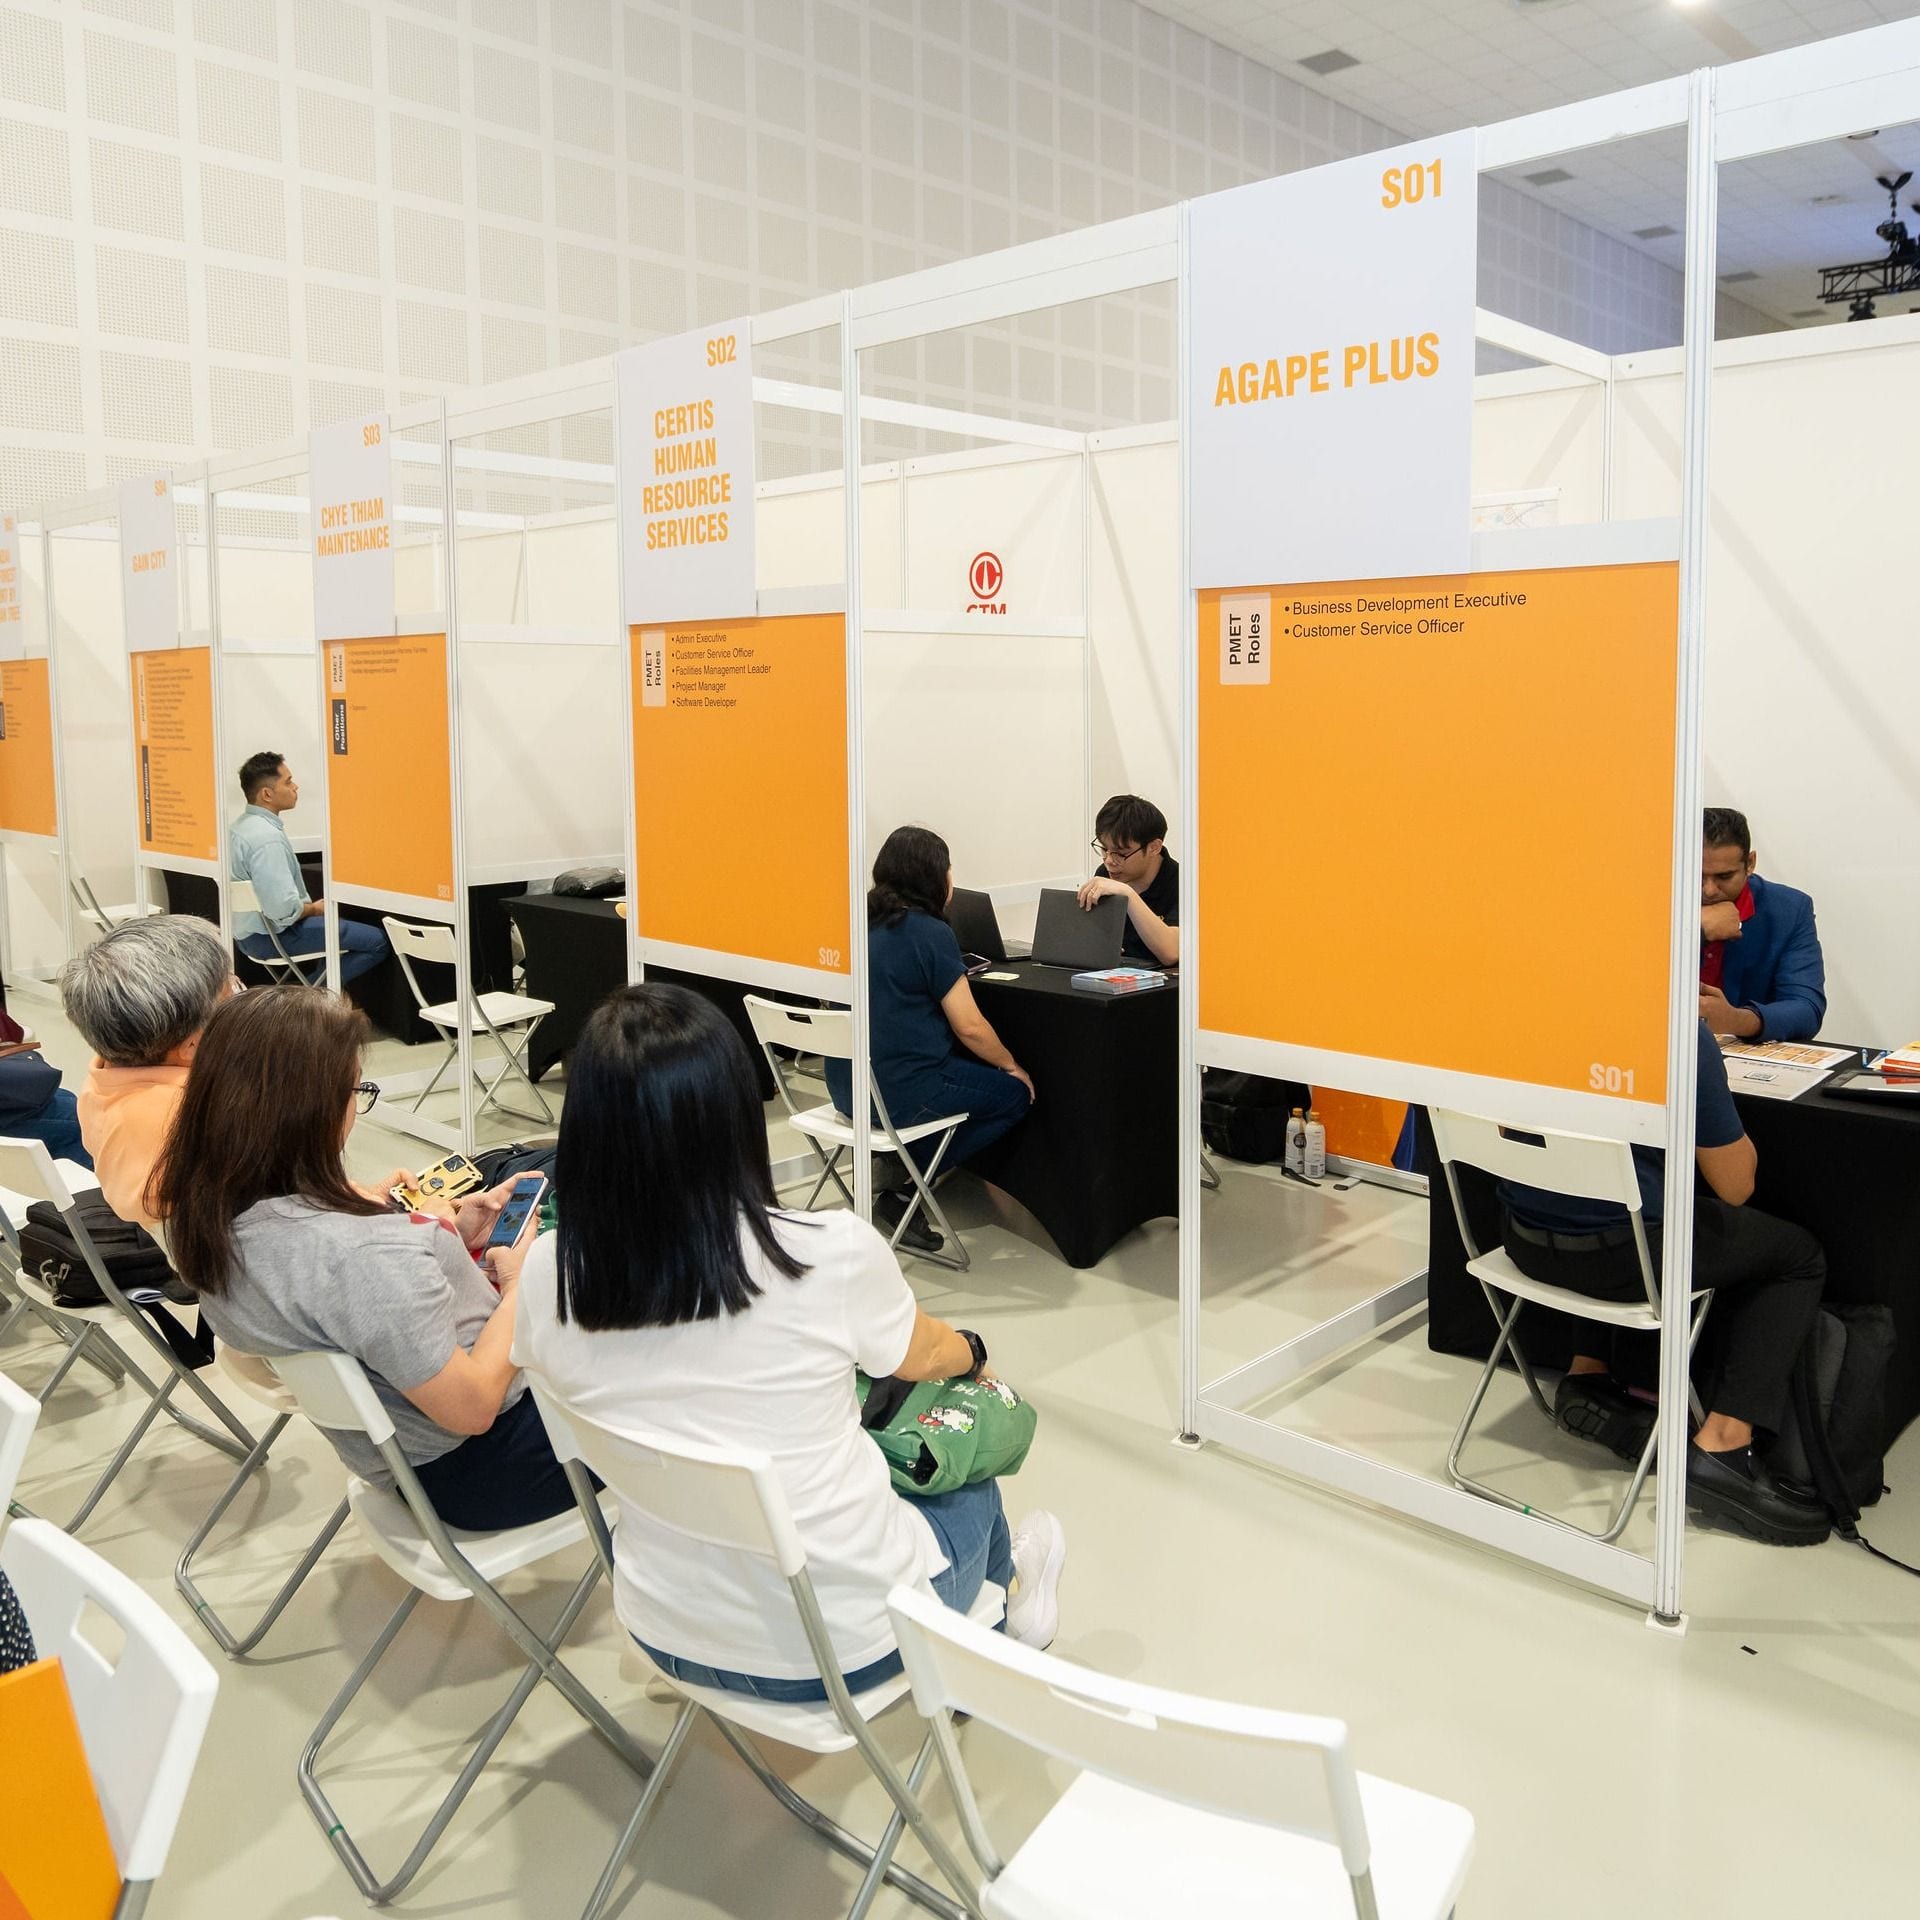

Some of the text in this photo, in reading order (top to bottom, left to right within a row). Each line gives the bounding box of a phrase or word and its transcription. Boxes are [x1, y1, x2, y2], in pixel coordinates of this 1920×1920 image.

[1381, 159, 1442, 208] S01
[707, 335, 737, 367] S02
[1214, 332, 1440, 407] AGAPE PLUS
[655, 399, 714, 439] CERTIS
[363, 423, 381, 448] S03
[655, 437, 717, 476] HUMAN
[643, 473, 731, 514] RESOURCE
[321, 497, 384, 529] CHYE THIAM
[317, 525, 390, 557] MAINTENANCE
[647, 511, 728, 550] SERVICES
[1292, 592, 1527, 615] Business Development Executive
[675, 633, 727, 644] Admin Executive
[1229, 614, 1242, 665] PMET
[1248, 613, 1260, 664] Roles
[1292, 619, 1465, 638] Customer Service Officer
[675, 647, 755, 660] Customer Service Officer
[704, 664, 746, 677] Management
[747, 664, 771, 674] Leader
[676, 681, 727, 693] Project Manager
[676, 696, 737, 709] Software Developer
[818, 946, 841, 968] S02
[1588, 1063, 1634, 1095] S01
